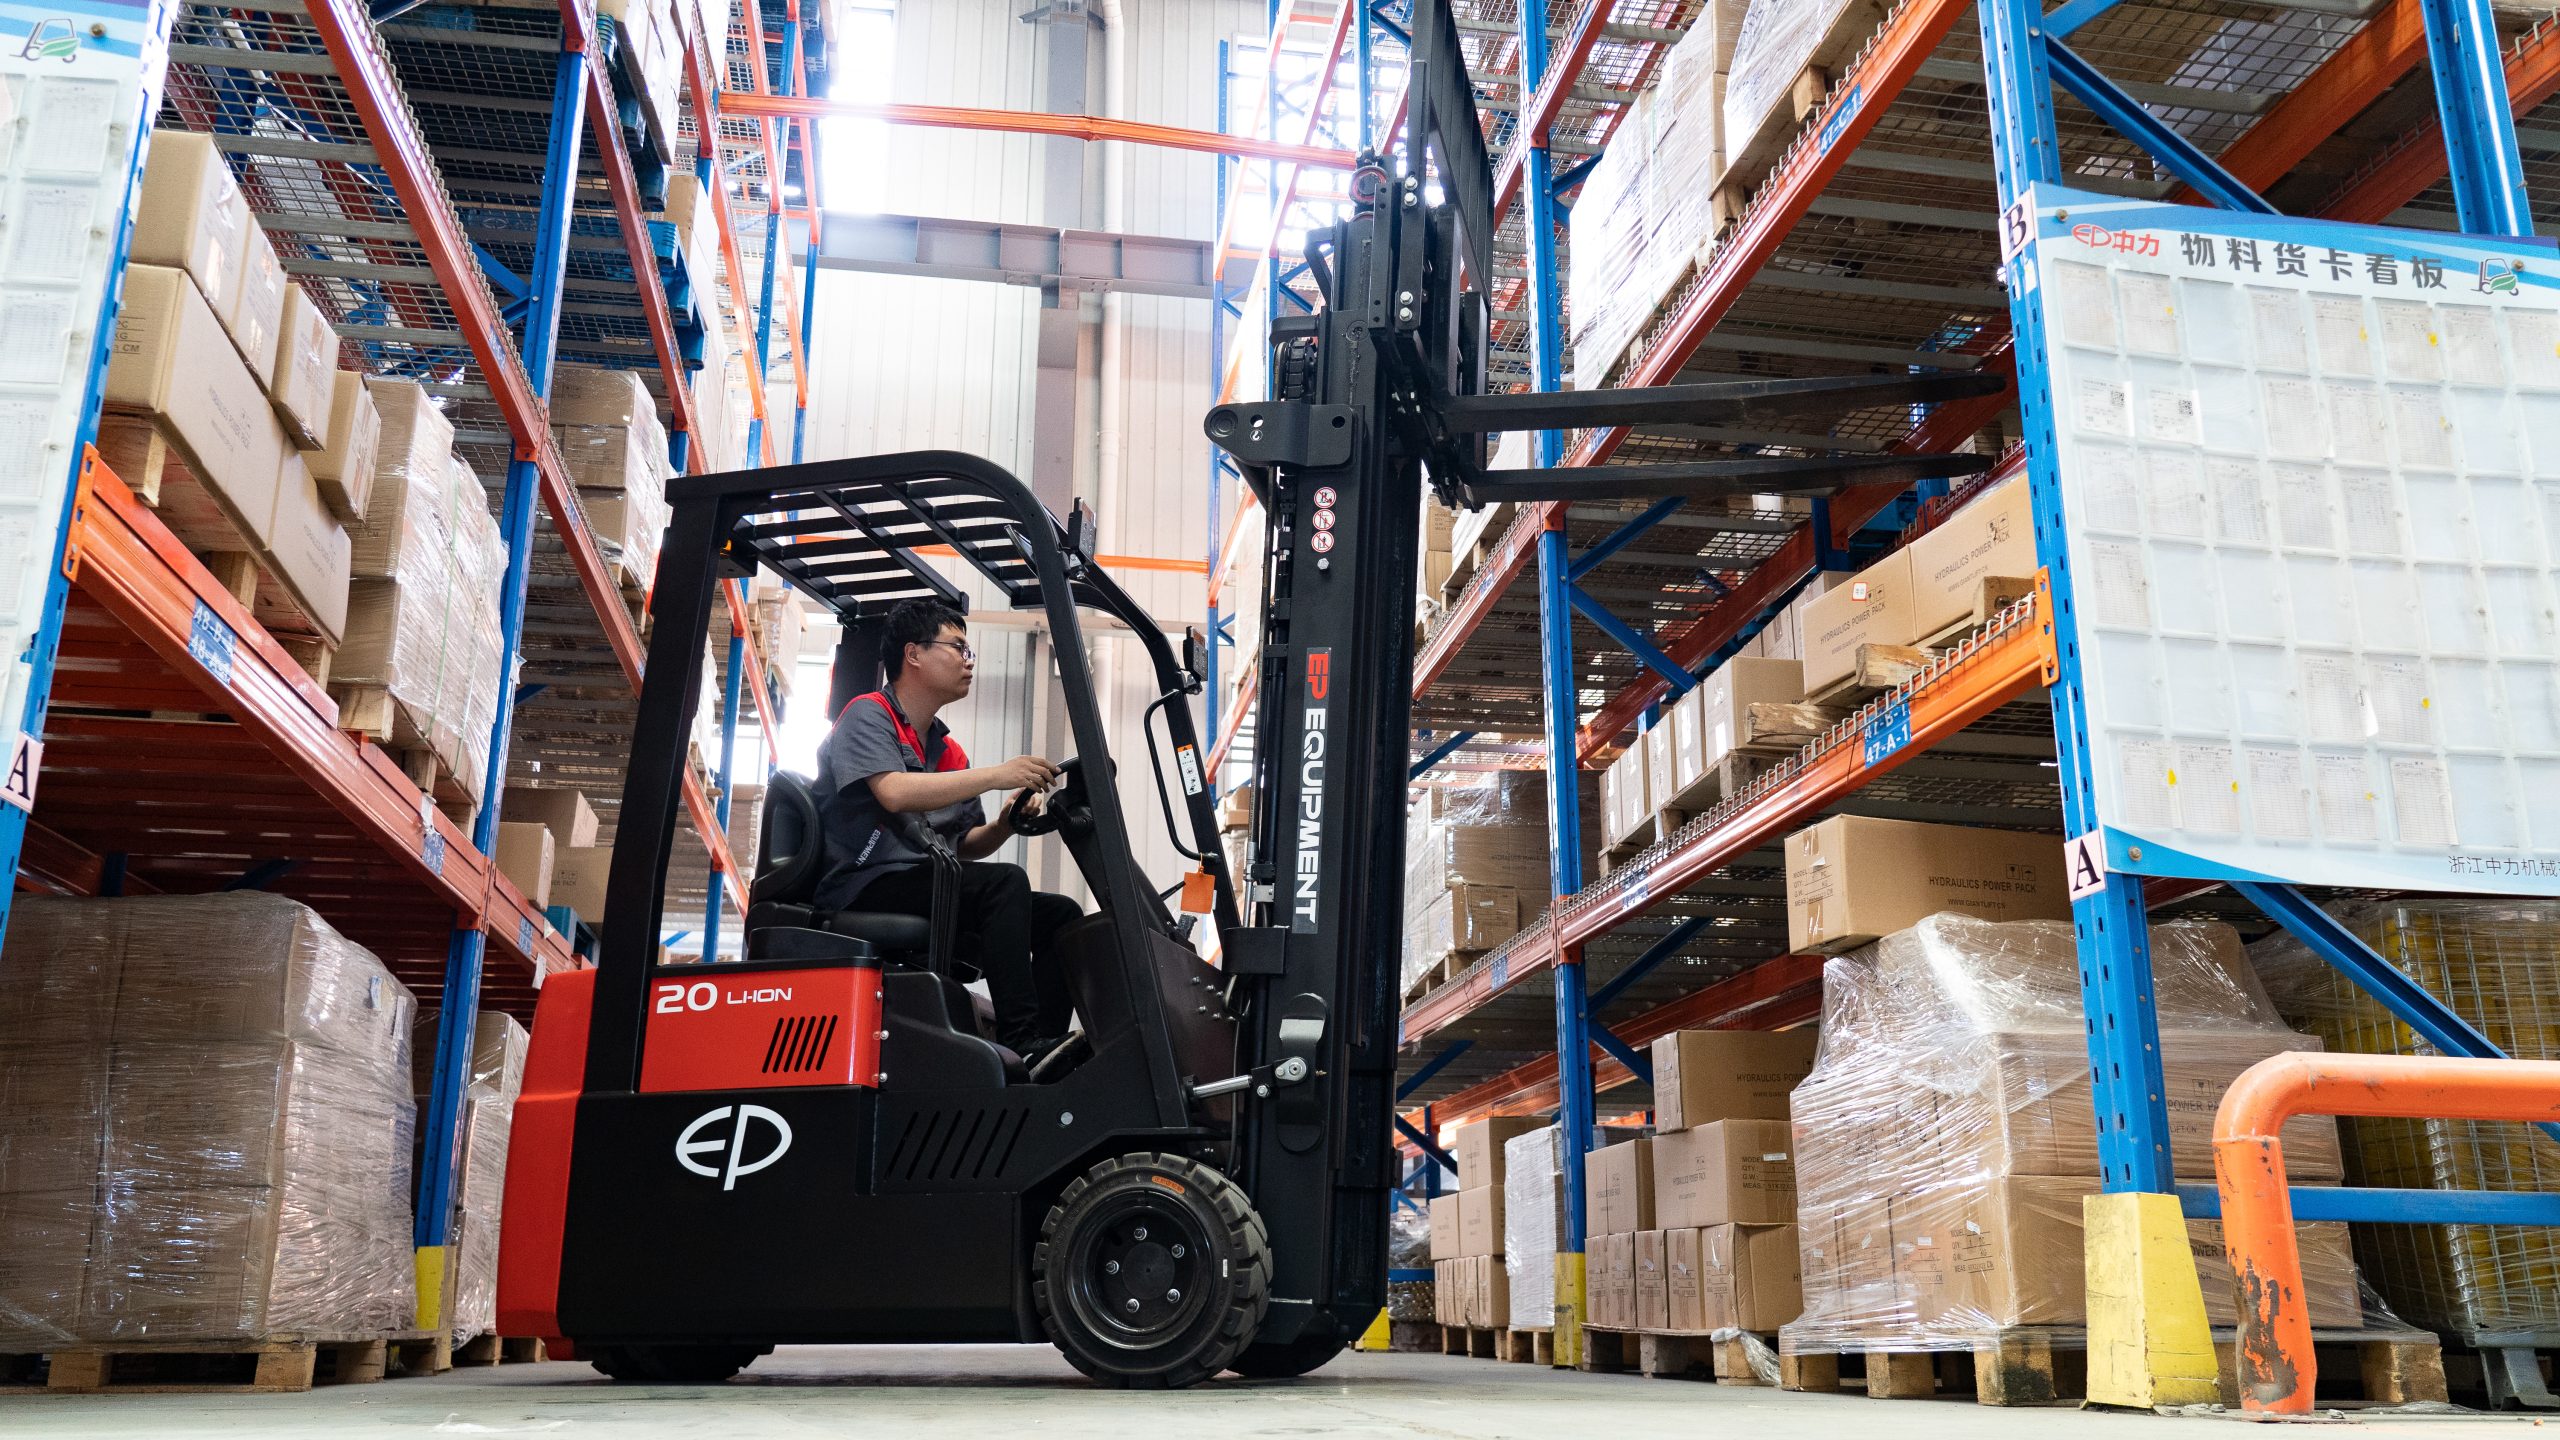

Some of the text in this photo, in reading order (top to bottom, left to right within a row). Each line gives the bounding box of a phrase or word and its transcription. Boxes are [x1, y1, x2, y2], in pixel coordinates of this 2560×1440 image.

[1821, 91, 1859, 150] 47-C-1
[2008, 203, 2027, 250] B
[2113, 230, 2160, 257] 中力
[2180, 232, 2448, 290] 物料货卡看板
[1935, 554, 1969, 583] HYDRAULICS
[1971, 540, 1993, 560] POWER
[1820, 601, 1886, 645] HYDRAULICS POWER PACK
[1866, 723, 1909, 763] 47-A-1
[5, 740, 31, 801] A
[1296, 653, 1329, 924] EP EQUIPMENT
[856, 829, 881, 867] EQUIPMENT
[2073, 839, 2101, 892] A
[2448, 855, 2560, 878] 浙江中力机械
[1928, 876, 2037, 894] HYDRAULICS POWER PACK
[656, 982, 718, 1014] 20
[1736, 1073, 1780, 1082] HYDRAULICS
[2168, 1100, 2203, 1112] POWER
[675, 1104, 793, 1191] EP
